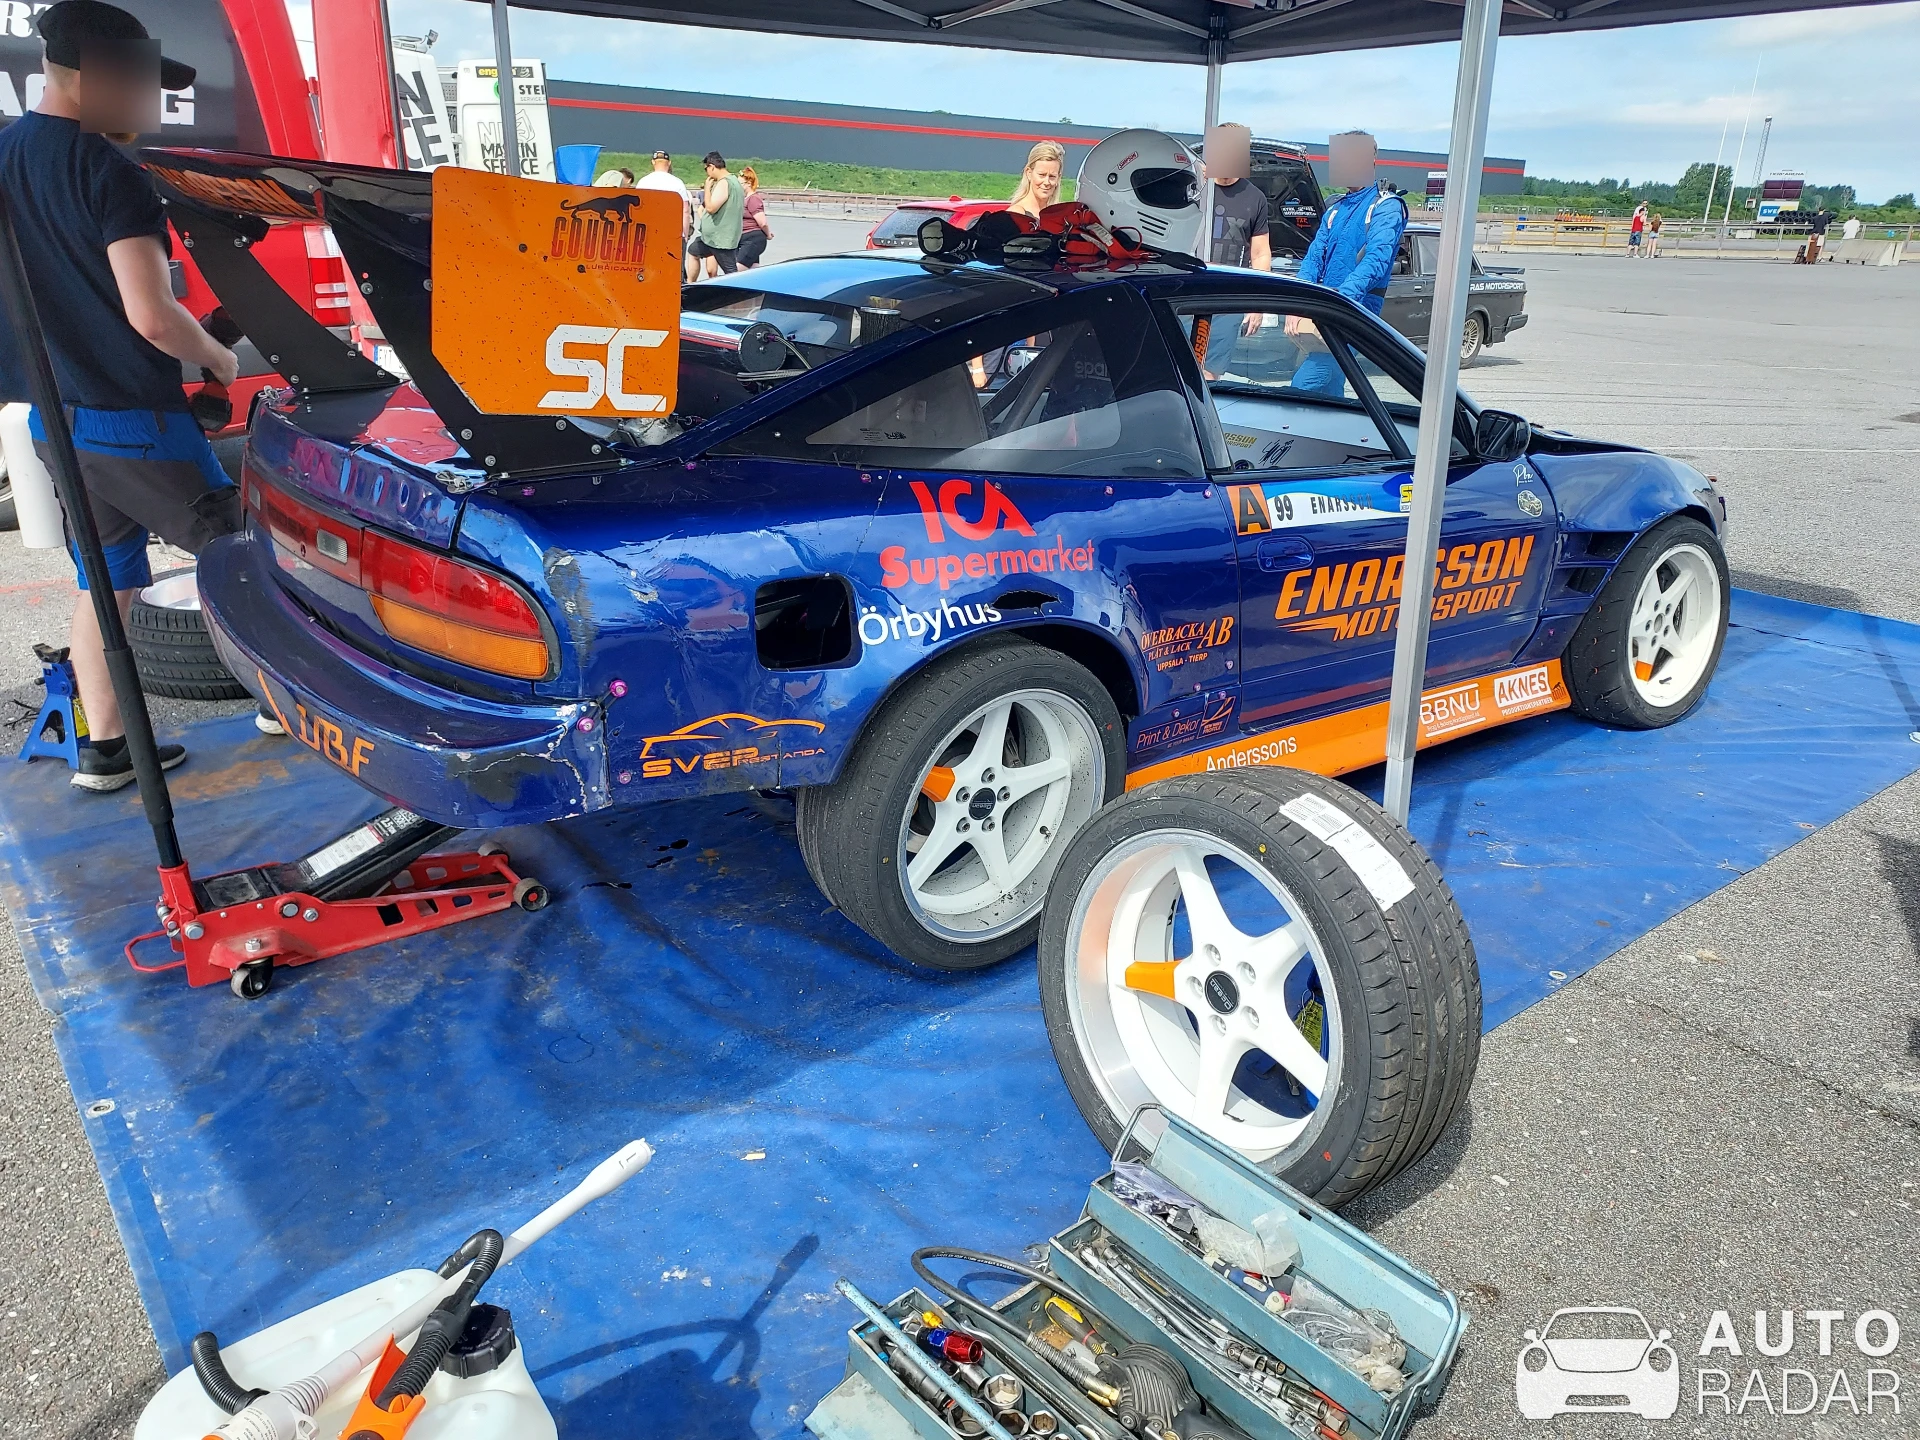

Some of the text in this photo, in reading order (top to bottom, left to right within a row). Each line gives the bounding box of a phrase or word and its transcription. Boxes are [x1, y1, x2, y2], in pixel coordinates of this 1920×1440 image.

[550, 215, 648, 264] COUGAR
[585, 264, 645, 273] LUBRICANTS
[909, 479, 1038, 543] ICA
[1238, 487, 1270, 532] A
[1274, 495, 1293, 521] 99
[1311, 492, 1373, 514] ENARSSON
[879, 534, 1095, 590] Supermarket
[858, 598, 1002, 645] Örbyhus
[1334, 581, 1522, 641] MOTSPORT
[1141, 616, 1234, 650] ÖVERBACKA AB
[1171, 642, 1193, 654] LACK
[1157, 657, 1183, 672] UPPSALA
[1189, 652, 1208, 663] TIERP
[1499, 671, 1548, 704] AKNES
[1137, 719, 1200, 748] Print & Dekor
[1206, 736, 1298, 771] Anderssons
